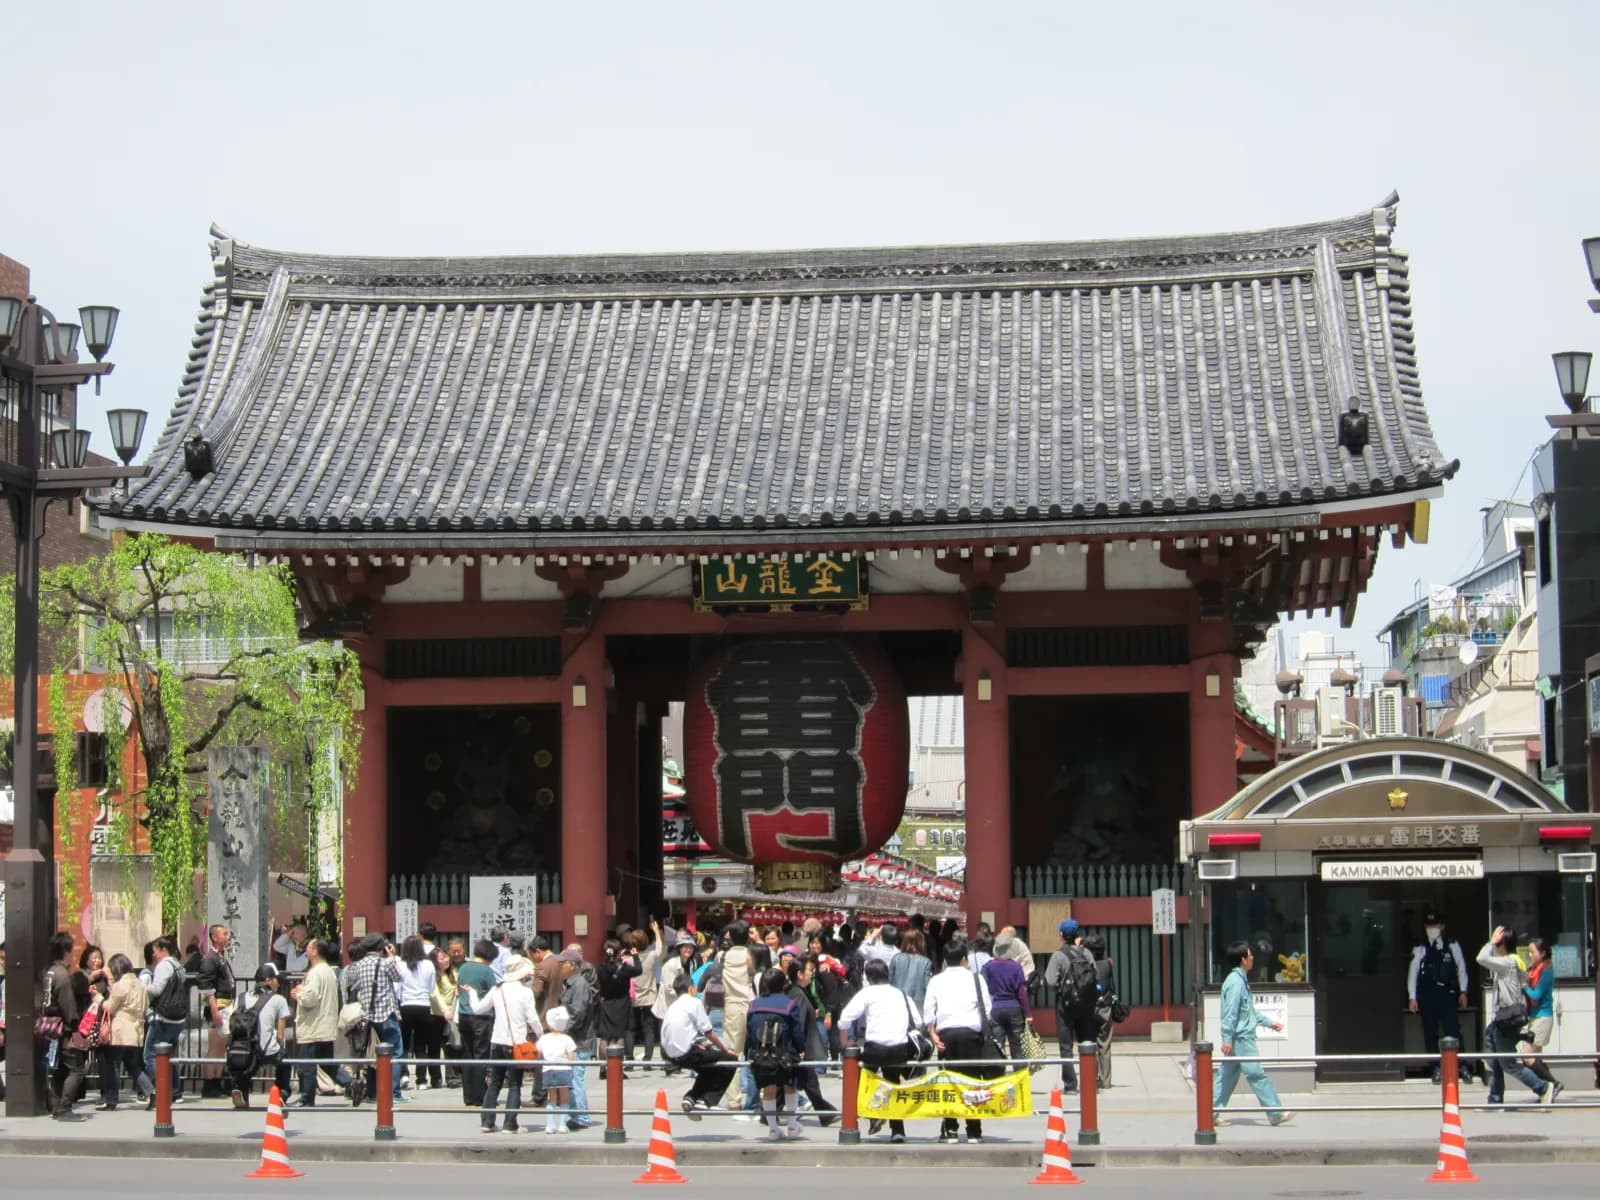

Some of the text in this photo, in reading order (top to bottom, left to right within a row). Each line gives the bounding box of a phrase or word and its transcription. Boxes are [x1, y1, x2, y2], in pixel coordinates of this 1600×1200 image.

[704, 638, 877, 860] 雷門
[1389, 824, 1481, 847] 雷門交番
[1331, 864, 1475, 878] KAMINARIMON KOBAN
[895, 1089, 957, 1104] 片手運転
